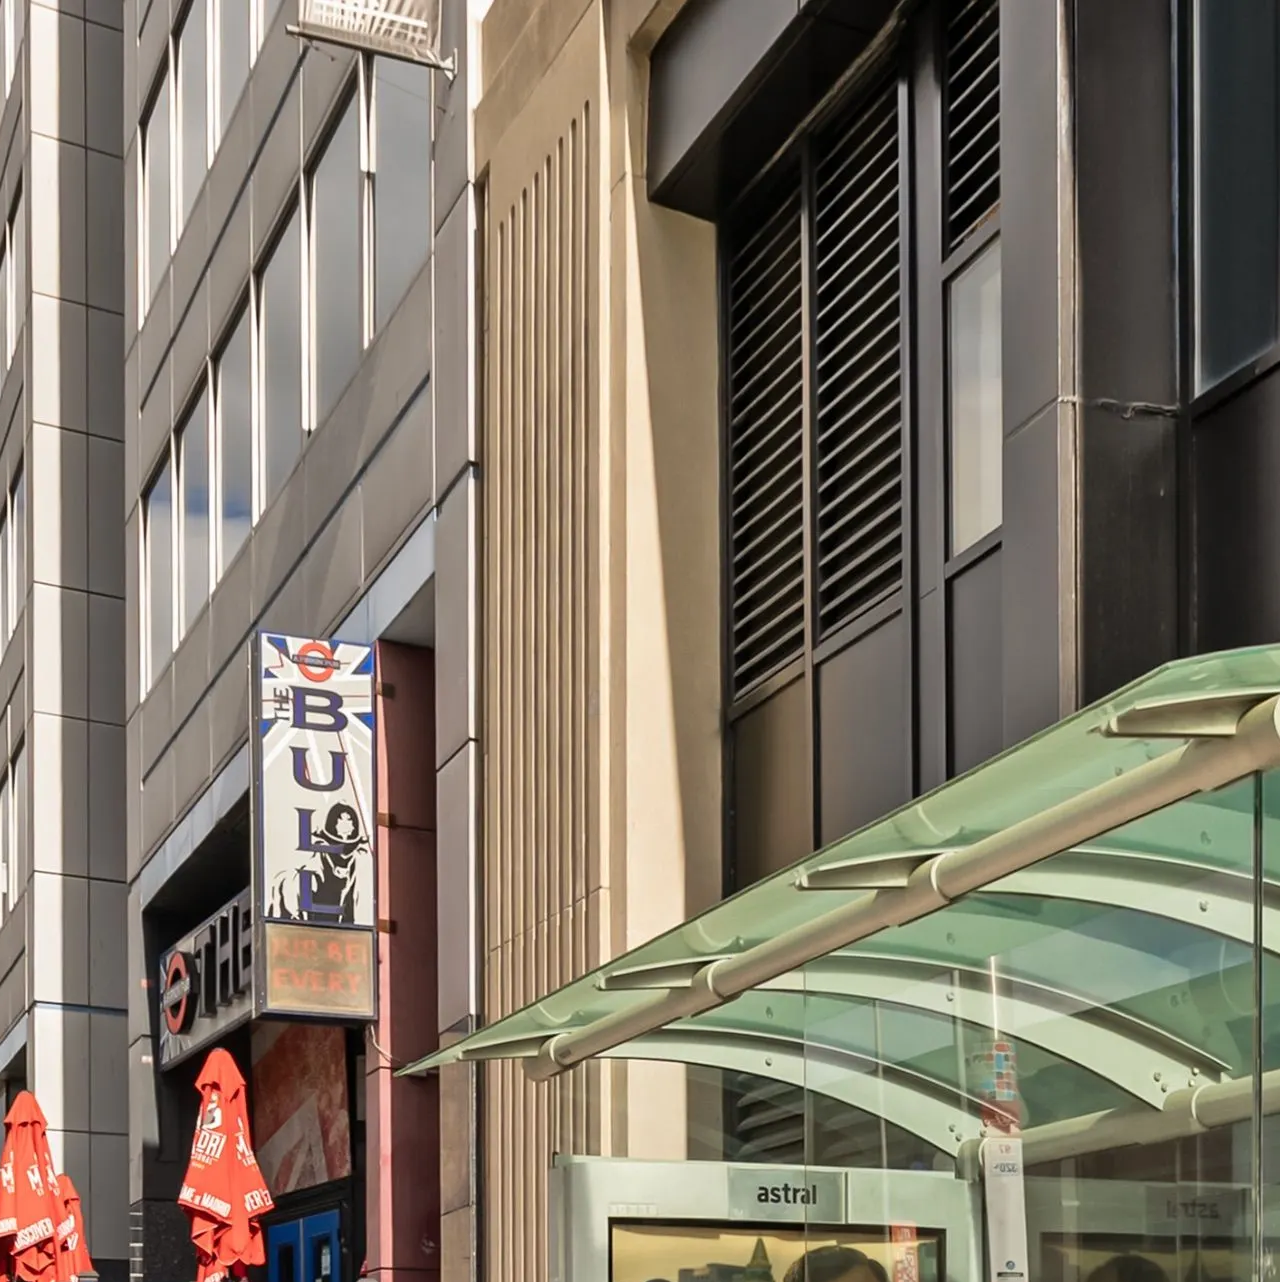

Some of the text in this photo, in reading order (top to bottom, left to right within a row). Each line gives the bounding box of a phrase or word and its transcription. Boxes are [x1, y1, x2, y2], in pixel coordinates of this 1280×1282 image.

[273, 687, 290, 721] THE
[289, 685, 348, 914] BULL
[273, 968, 362, 994] EVERY
[757, 1183, 817, 1204] astral
